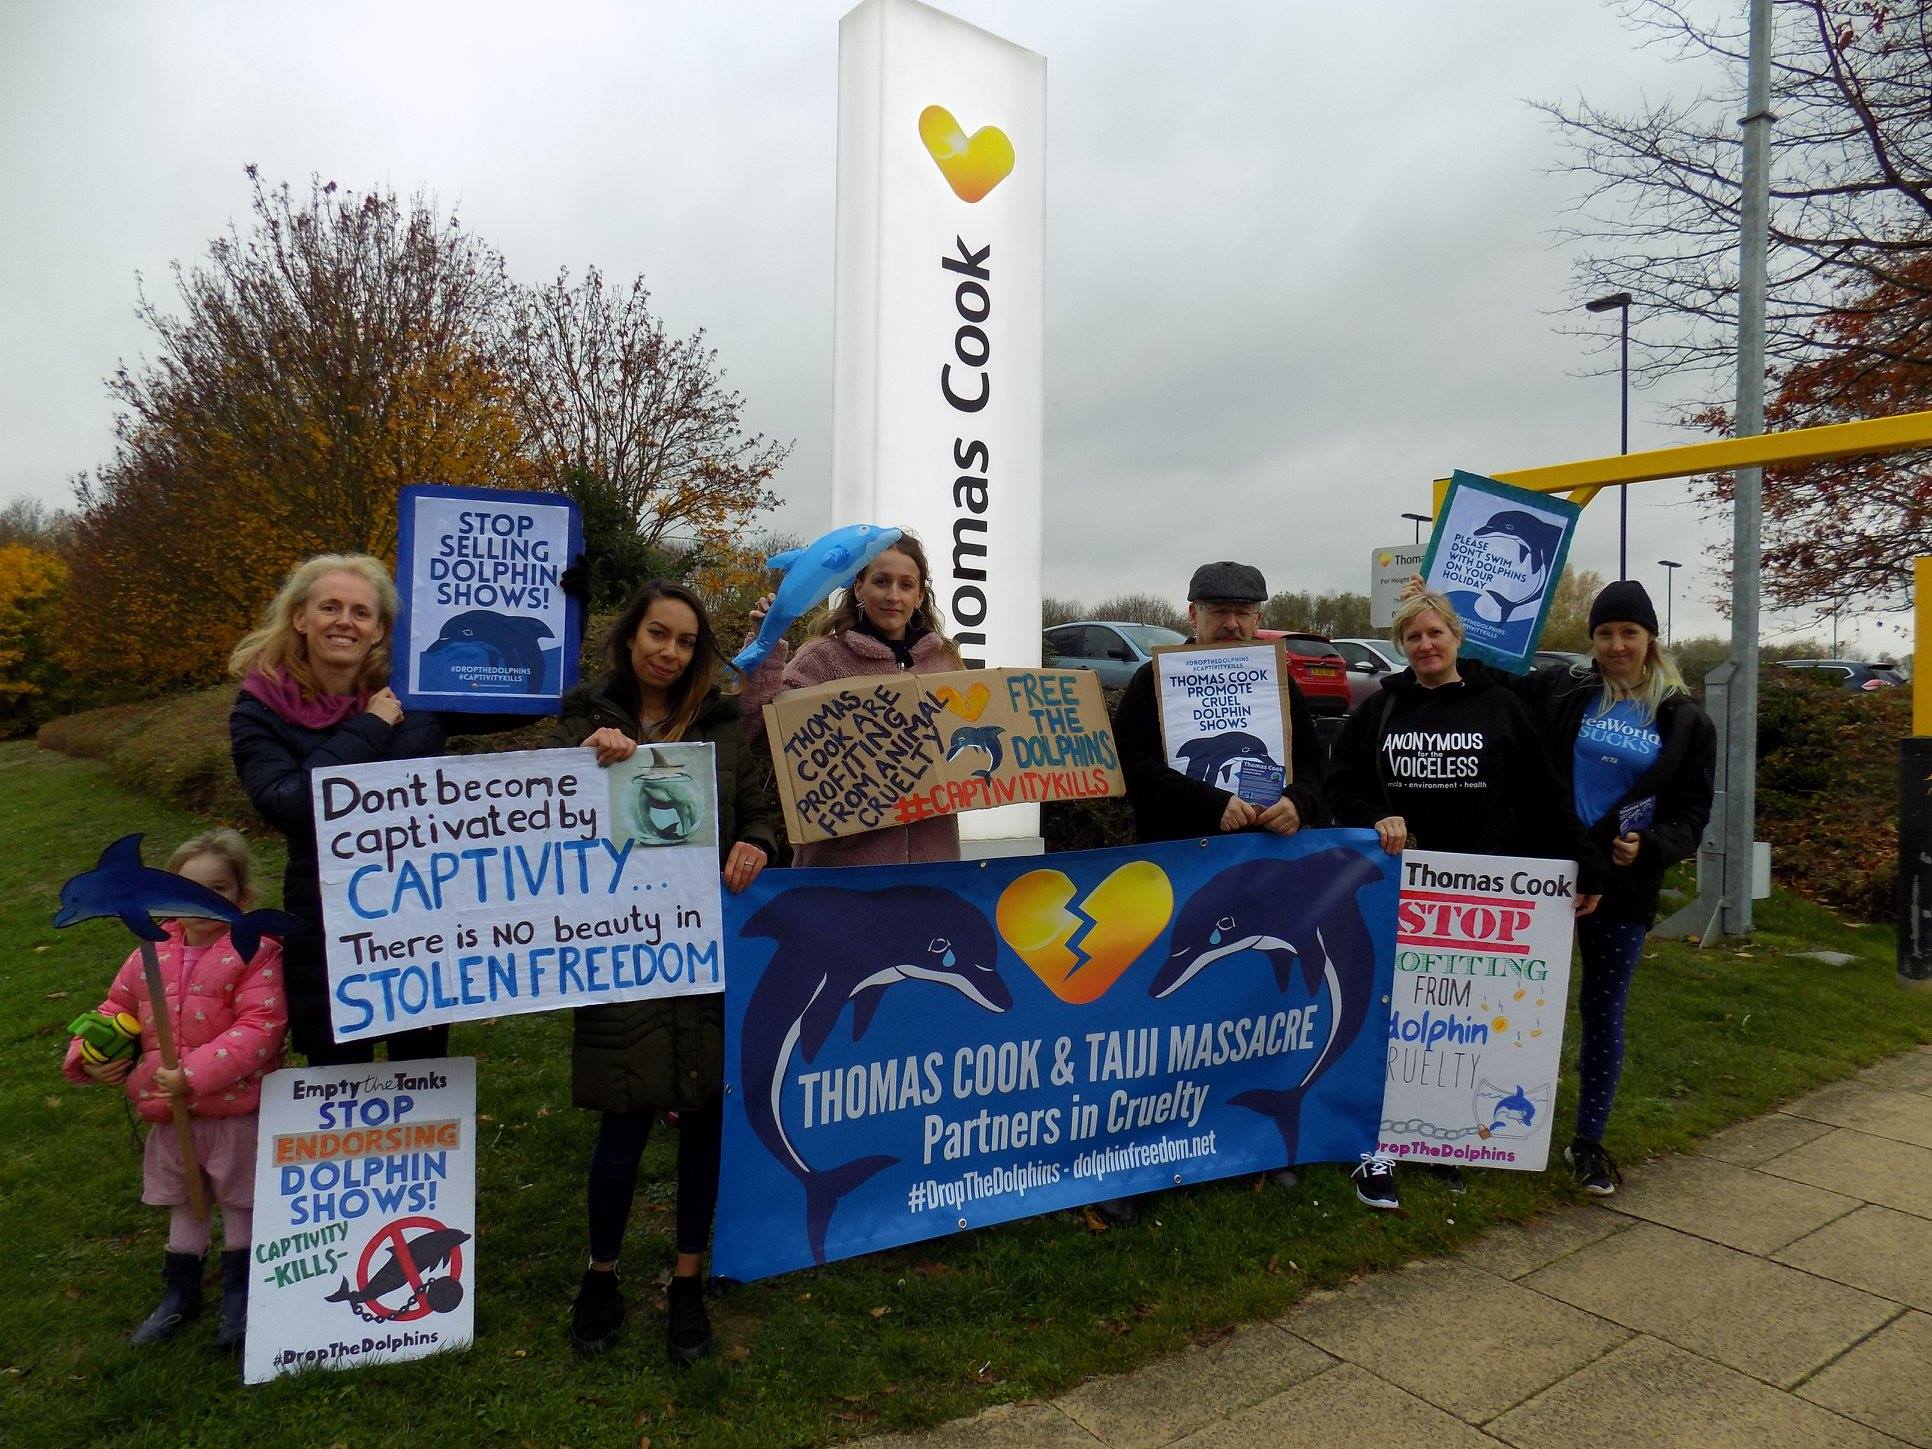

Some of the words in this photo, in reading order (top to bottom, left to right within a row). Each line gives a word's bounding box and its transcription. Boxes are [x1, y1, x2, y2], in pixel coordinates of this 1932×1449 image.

[941, 234, 991, 413] Cook
[459, 511, 534, 538] STOP
[1454, 533, 1489, 550] PLEASE
[440, 535, 549, 563] SELLING
[952, 437, 990, 670] homas
[1449, 551, 1473, 566] WITH
[1476, 560, 1527, 582] DOLPHINS
[1451, 542, 1483, 559] DON'T
[1484, 553, 1512, 568] SWIM
[430, 558, 557, 586] DOLPHIN
[1442, 569, 1487, 589] HOLIDAY
[1446, 561, 1462, 572] ON
[1465, 566, 1494, 582] YOUR
[437, 582, 549, 610] SHOWS!
[451, 665, 531, 675] #DROPTHEDOLPHINS
[459, 673, 523, 682] #CAPTIVITYKILLS
[1170, 672, 1225, 687] THOMAS
[1229, 670, 1268, 683] COOK
[1186, 656, 1250, 666] #DROPTHEDOLPHINS
[1193, 662, 1244, 672] #CAPTIVITYKILLS
[1007, 672, 1080, 713] FREE
[1188, 683, 1253, 698] PROMOTE
[1202, 696, 1241, 708] CRUEL
[784, 690, 861, 758] THOMAS
[1028, 707, 1084, 735] THE
[1193, 706, 1251, 720] DOLPHIN
[1200, 718, 1248, 731] SHOWS
[797, 730, 853, 781] COOK
[852, 684, 901, 735] ARE
[1011, 730, 1119, 770] DOLPHINS
[1382, 731, 1483, 751] ANONYMOUS
[1578, 726, 1650, 754] SUCKS
[797, 708, 910, 825] PROFITING
[818, 772, 878, 836] FROM
[876, 690, 950, 779] ANIMAL
[858, 726, 946, 829] CRUELTY
[1390, 756, 1479, 778] VOICELESS
[322, 772, 427, 822] Don't
[436, 769, 577, 805] become
[892, 768, 1111, 823] #CAPTIVITYKILLS
[331, 800, 550, 873] captivated
[560, 800, 597, 840] by
[1405, 862, 1504, 892] Thomas
[1510, 871, 1573, 898] Cook
[339, 931, 443, 966] There
[456, 923, 478, 950] is
[493, 921, 534, 948] NO
[555, 905, 660, 946] beauty
[676, 906, 702, 929] in
[1397, 901, 1531, 941] STOP
[1396, 951, 1549, 981] OFITING
[336, 952, 517, 1034] STOLEN
[530, 940, 719, 997] FREEDOM
[1414, 976, 1471, 1008] FROM
[1388, 1010, 1488, 1051] dolphin
[799, 1051, 943, 1128] THOMAS
[952, 1039, 1042, 1100] COOK
[1050, 1036, 1074, 1085] &
[1086, 1026, 1160, 1082] TAIJI
[1168, 1005, 1317, 1073] MASSACRE
[1386, 1046, 1480, 1089] RUELTY
[293, 1079, 360, 1101] Empty
[360, 1075, 398, 1094] the
[394, 1071, 448, 1090] Tanks
[319, 1095, 414, 1130] STOP
[923, 1100, 1060, 1164] Partners
[1071, 1096, 1097, 1141] in
[1106, 1081, 1209, 1135] Cruelty
[277, 1123, 456, 1162] ENDORSING
[281, 1151, 447, 1196] DOLPHIN
[908, 1160, 1060, 1214] #DropTheDolphins
[1073, 1129, 1216, 1181] dolphinfreedom.net
[291, 1181, 437, 1225] SHOWS!
[255, 1220, 349, 1264] CAPTIVITY
[273, 1330, 439, 1367] #DropTheDolphins
